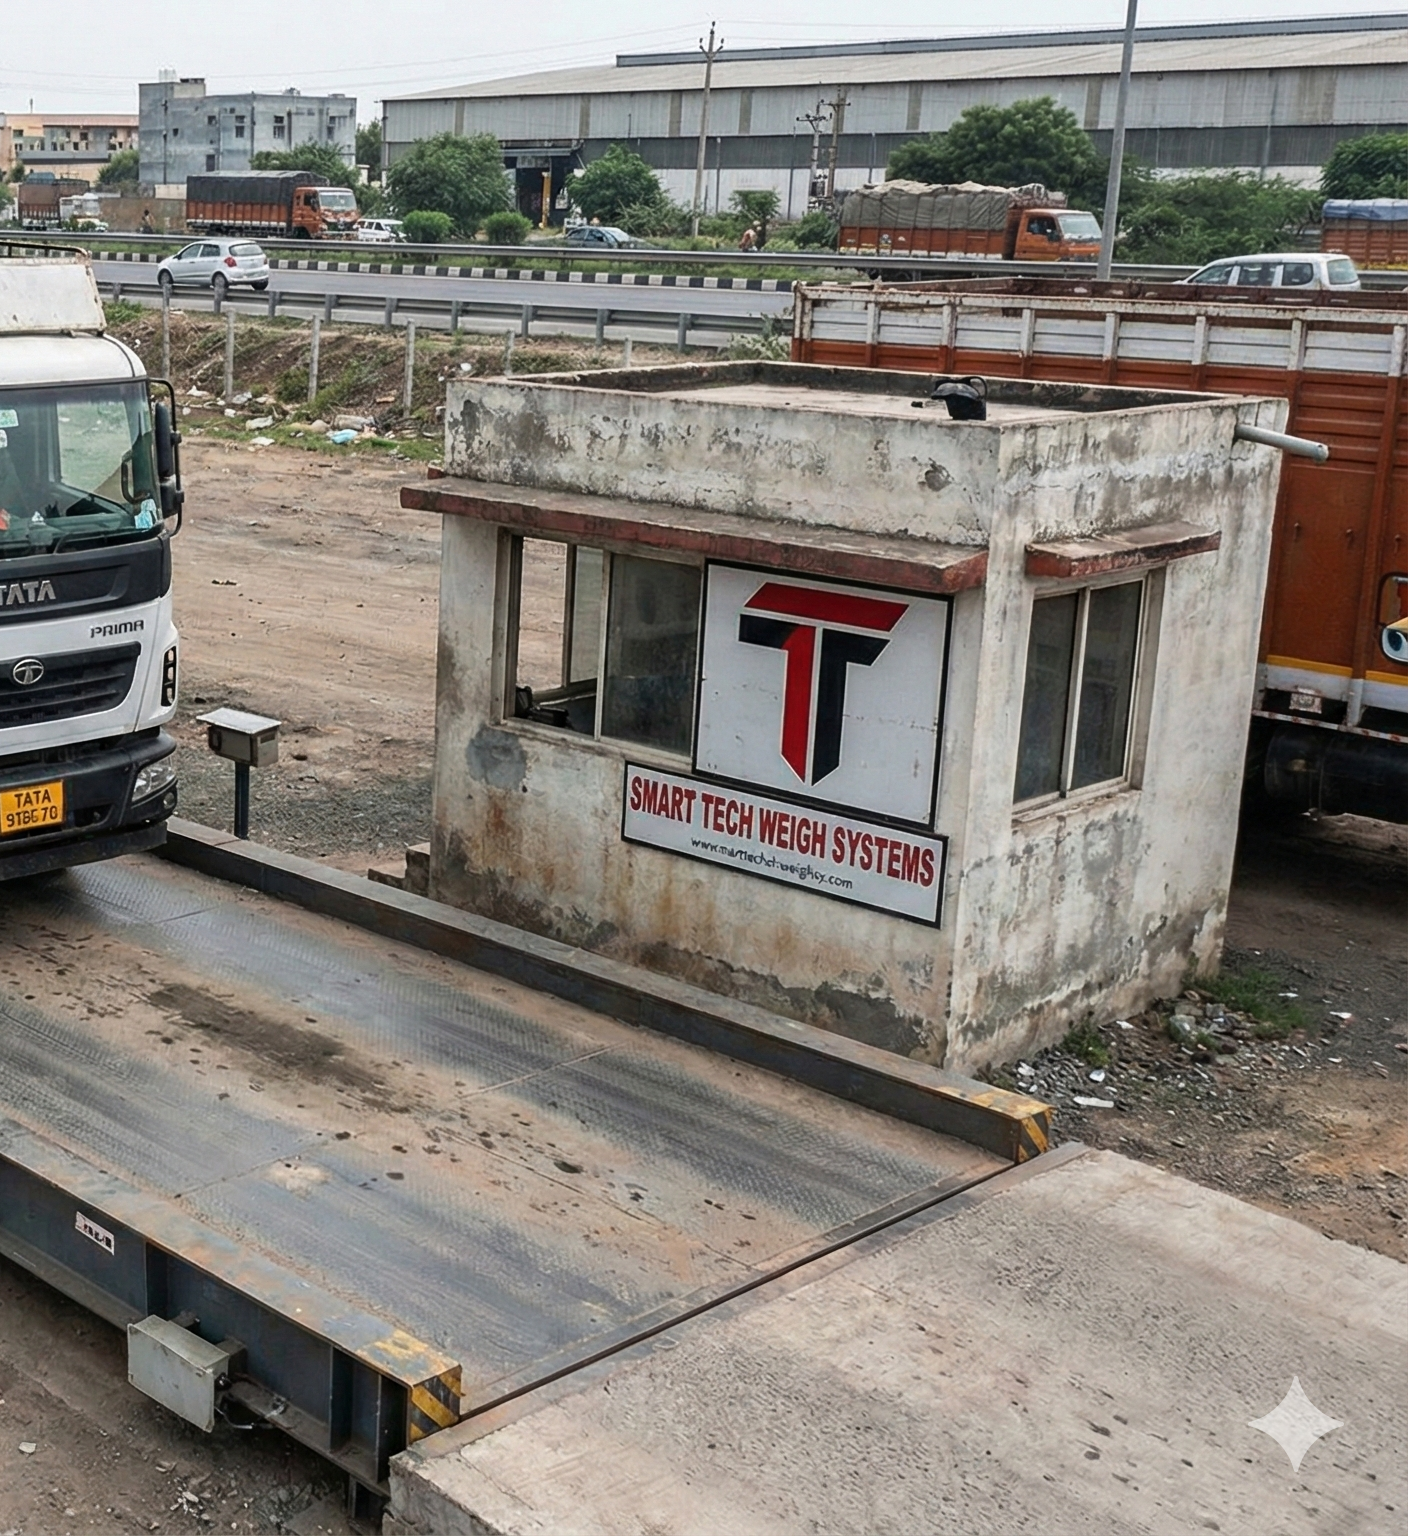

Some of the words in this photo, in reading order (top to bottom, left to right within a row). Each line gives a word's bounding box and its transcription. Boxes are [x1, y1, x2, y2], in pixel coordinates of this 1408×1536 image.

[90, 619, 144, 638] PRIMA
[14, 789, 51, 808] TATA
[630, 775, 697, 824] SMART
[701, 792, 753, 840] TECH
[759, 807, 827, 859] WEIGH
[831, 826, 935, 888] SYSTEMS
